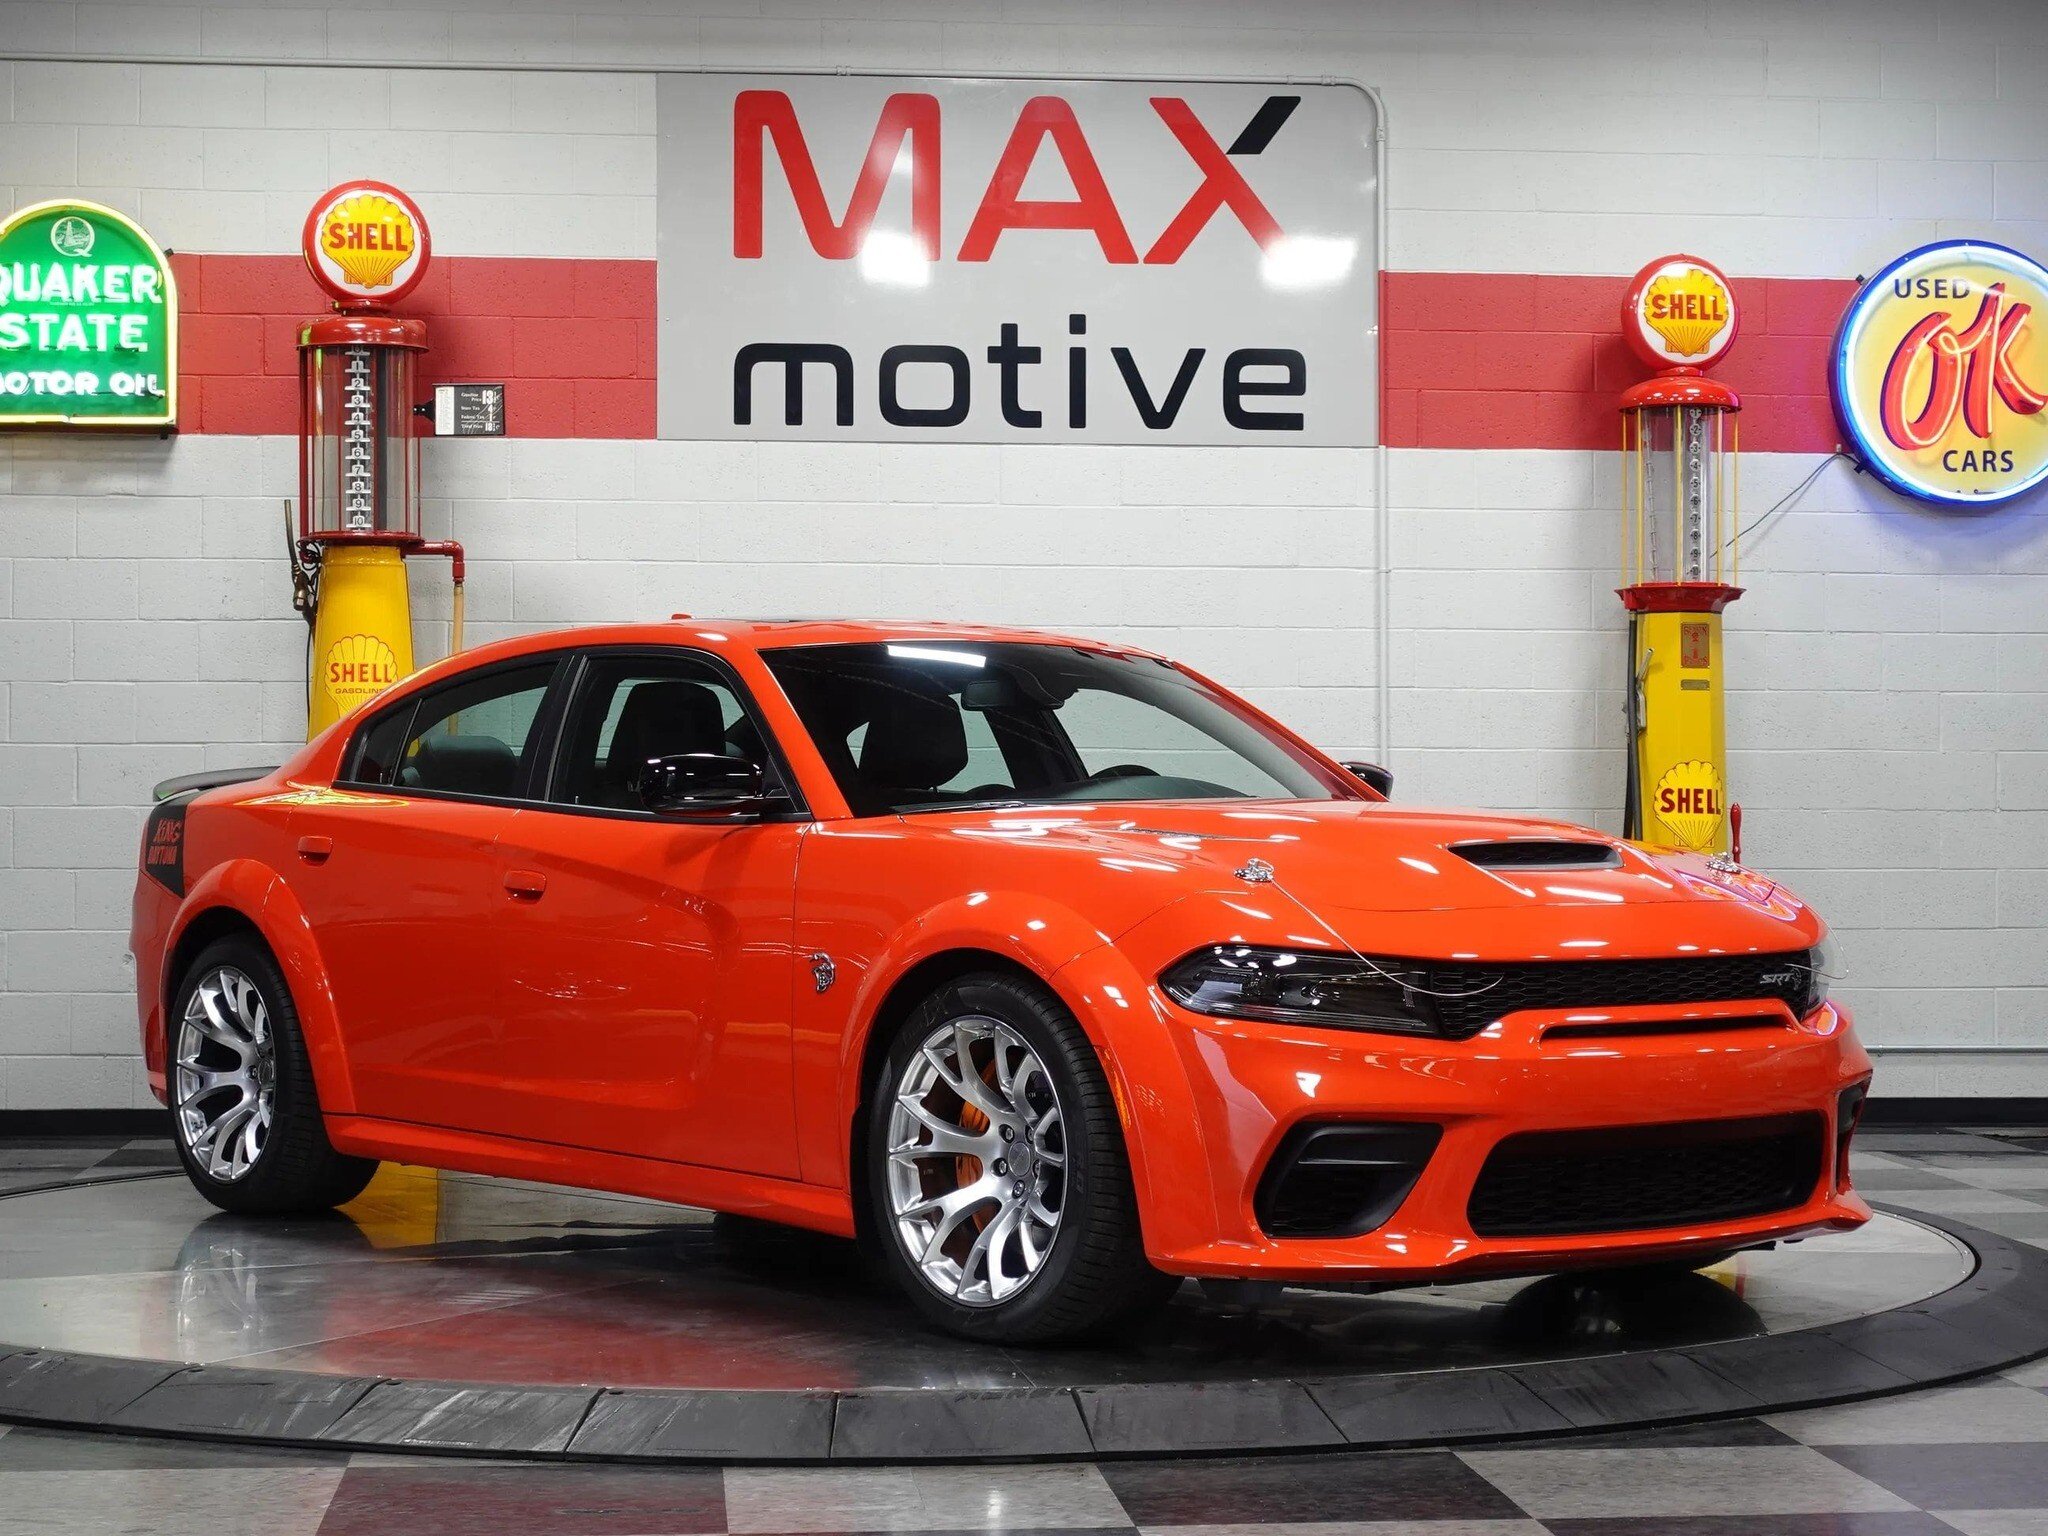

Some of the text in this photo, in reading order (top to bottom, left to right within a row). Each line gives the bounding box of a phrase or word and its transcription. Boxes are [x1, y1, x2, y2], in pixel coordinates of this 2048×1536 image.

[734, 90, 1302, 265] MAX
[329, 222, 408, 251] SHELL
[1894, 278, 1970, 299] USED
[1652, 294, 1724, 320] SHELL
[0, 312, 148, 351] STATE
[734, 314, 1306, 431] motive
[1881, 282, 2048, 450] OK
[0, 371, 99, 396] OTOR
[354, 379, 361, 388] 2
[354, 396, 361, 405] 3
[354, 414, 361, 422] 4
[354, 431, 361, 440] 5
[354, 449, 361, 457] 6
[1943, 450, 2014, 472] CARS
[355, 466, 361, 475] 7
[354, 483, 362, 491] 8
[355, 500, 362, 508] 9
[354, 517, 363, 525] 10
[330, 662, 392, 683] SHELL
[1660, 788, 1721, 815] SHELL
[1760, 973, 1795, 985] SRT
